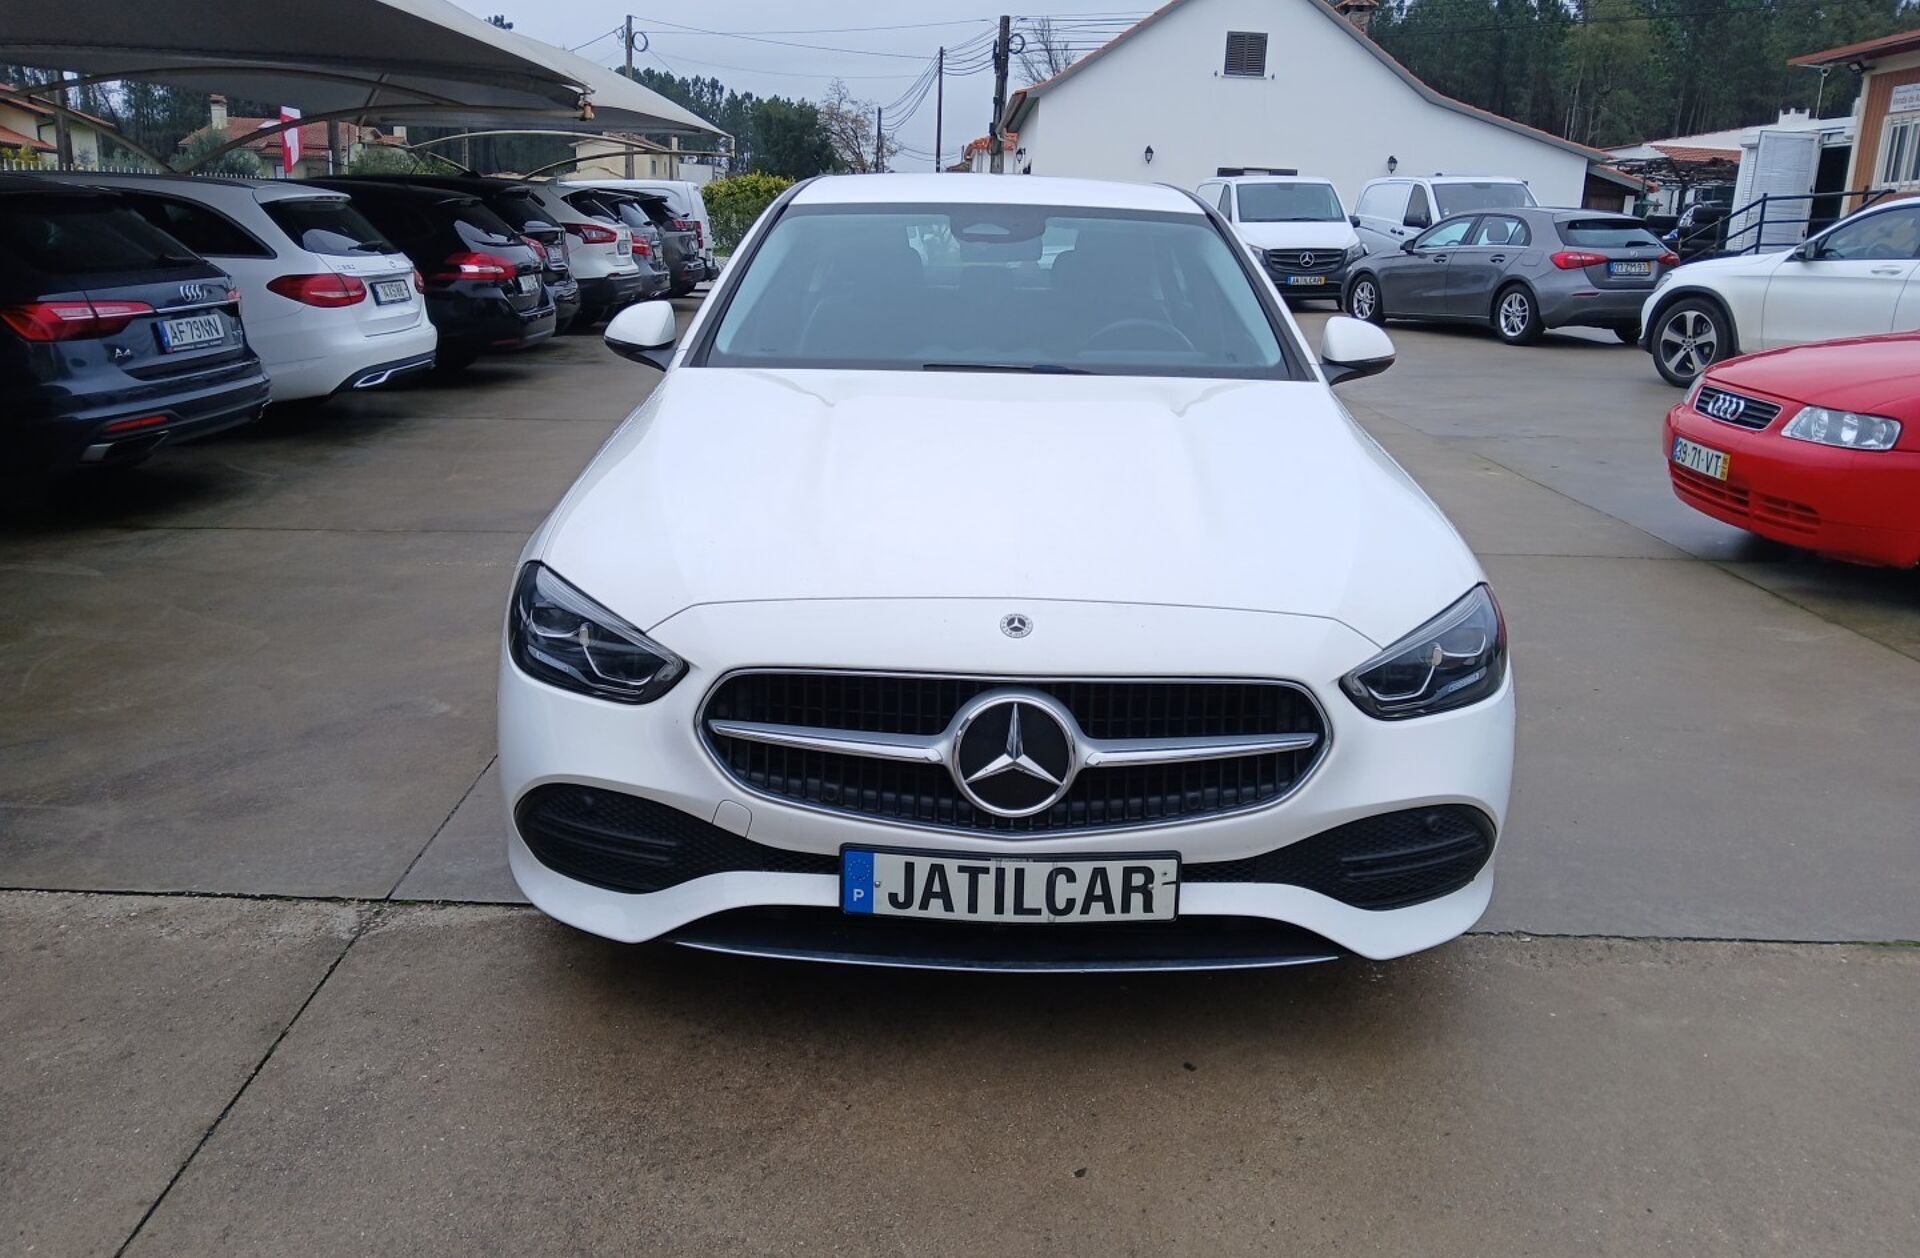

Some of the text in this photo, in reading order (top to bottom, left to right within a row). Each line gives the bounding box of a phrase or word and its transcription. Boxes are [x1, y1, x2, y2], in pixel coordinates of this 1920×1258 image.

[114, 348, 131, 359] A4
[888, 861, 1155, 916] JATILCAR
[853, 889, 864, 902] P
